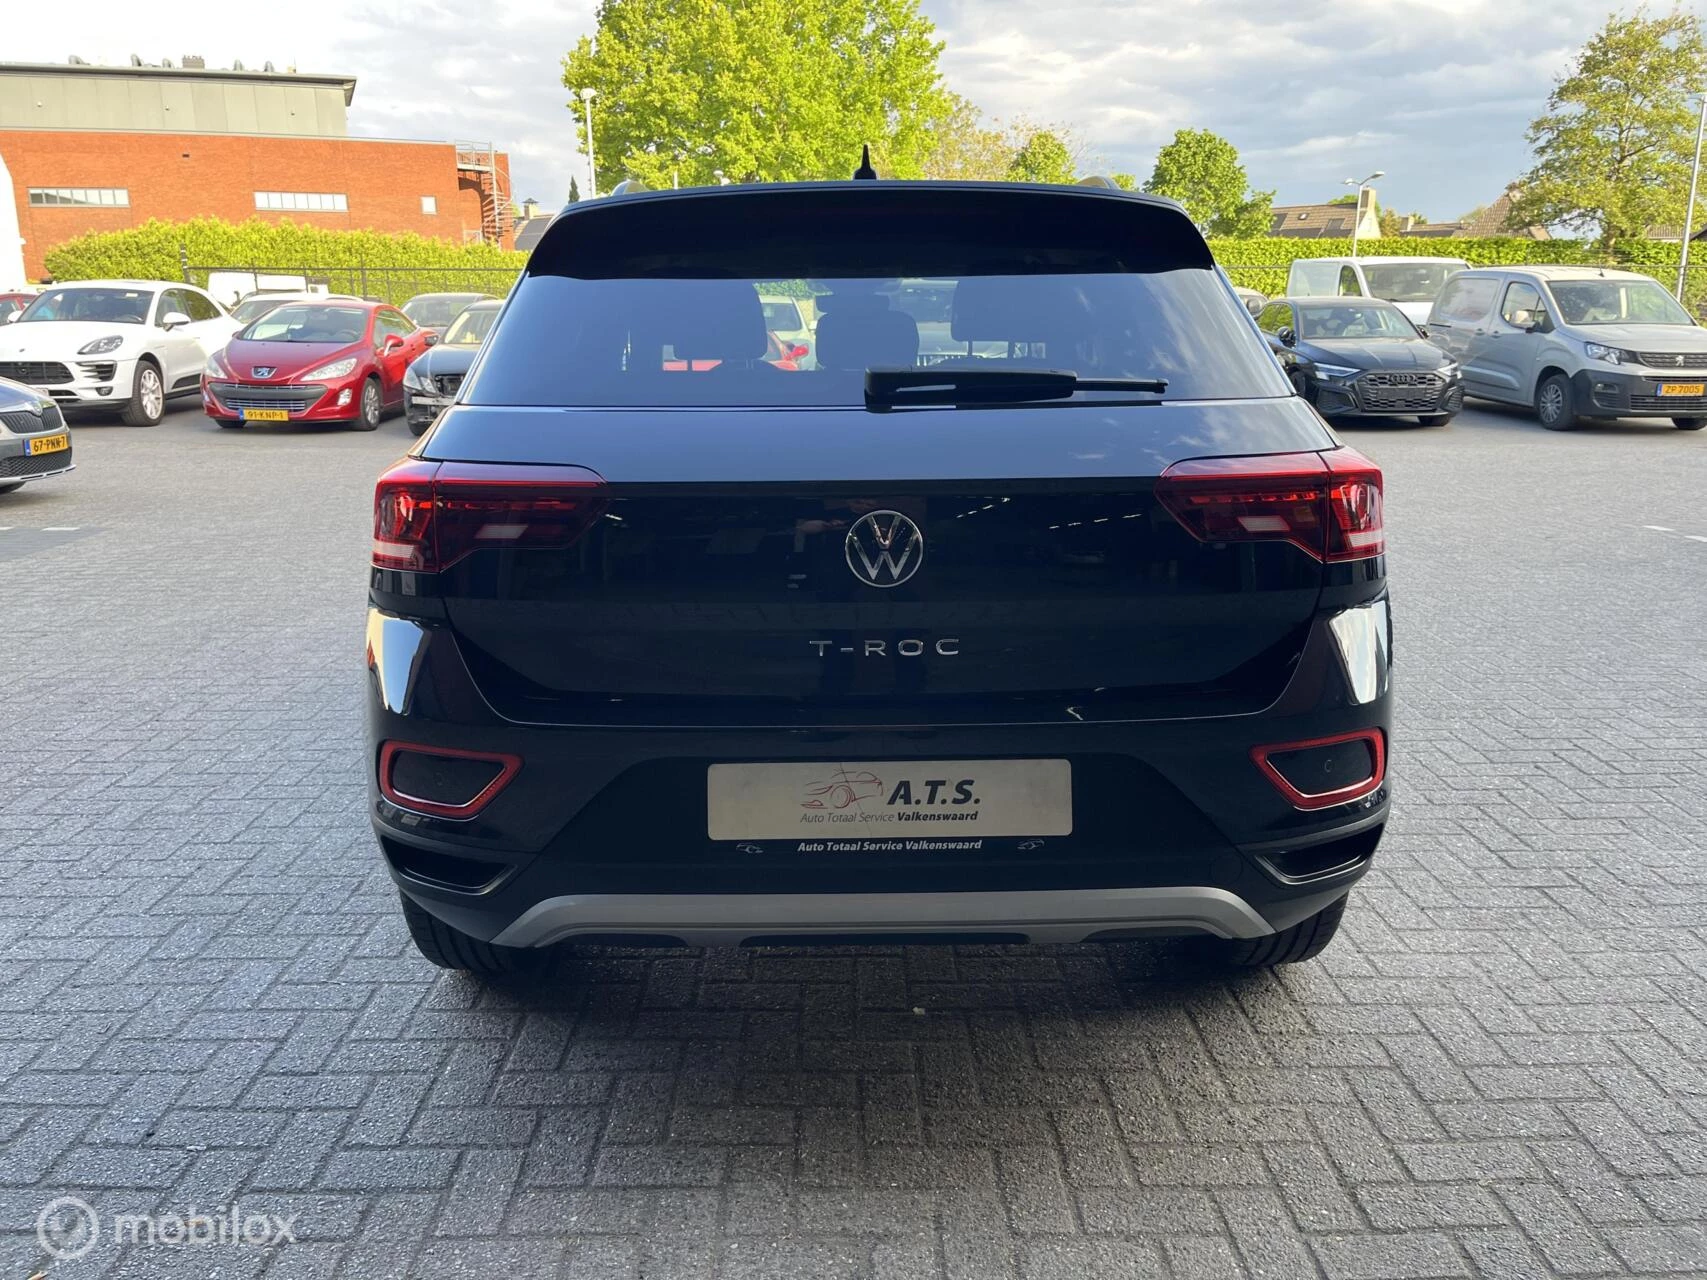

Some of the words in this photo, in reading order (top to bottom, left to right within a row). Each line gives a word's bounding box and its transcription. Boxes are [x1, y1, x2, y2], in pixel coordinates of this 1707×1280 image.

[809, 638, 960, 656] T-ROC
[887, 778, 981, 806] A.T.S.
[800, 812, 825, 823] Auto
[827, 811, 856, 823] Totaal
[858, 811, 895, 823] Service
[897, 811, 978, 822] Valkenswaard
[797, 841, 825, 852] Auto
[826, 841, 861, 852] Totaal
[862, 841, 903, 852] Service
[905, 839, 982, 851] Valkenswaard
